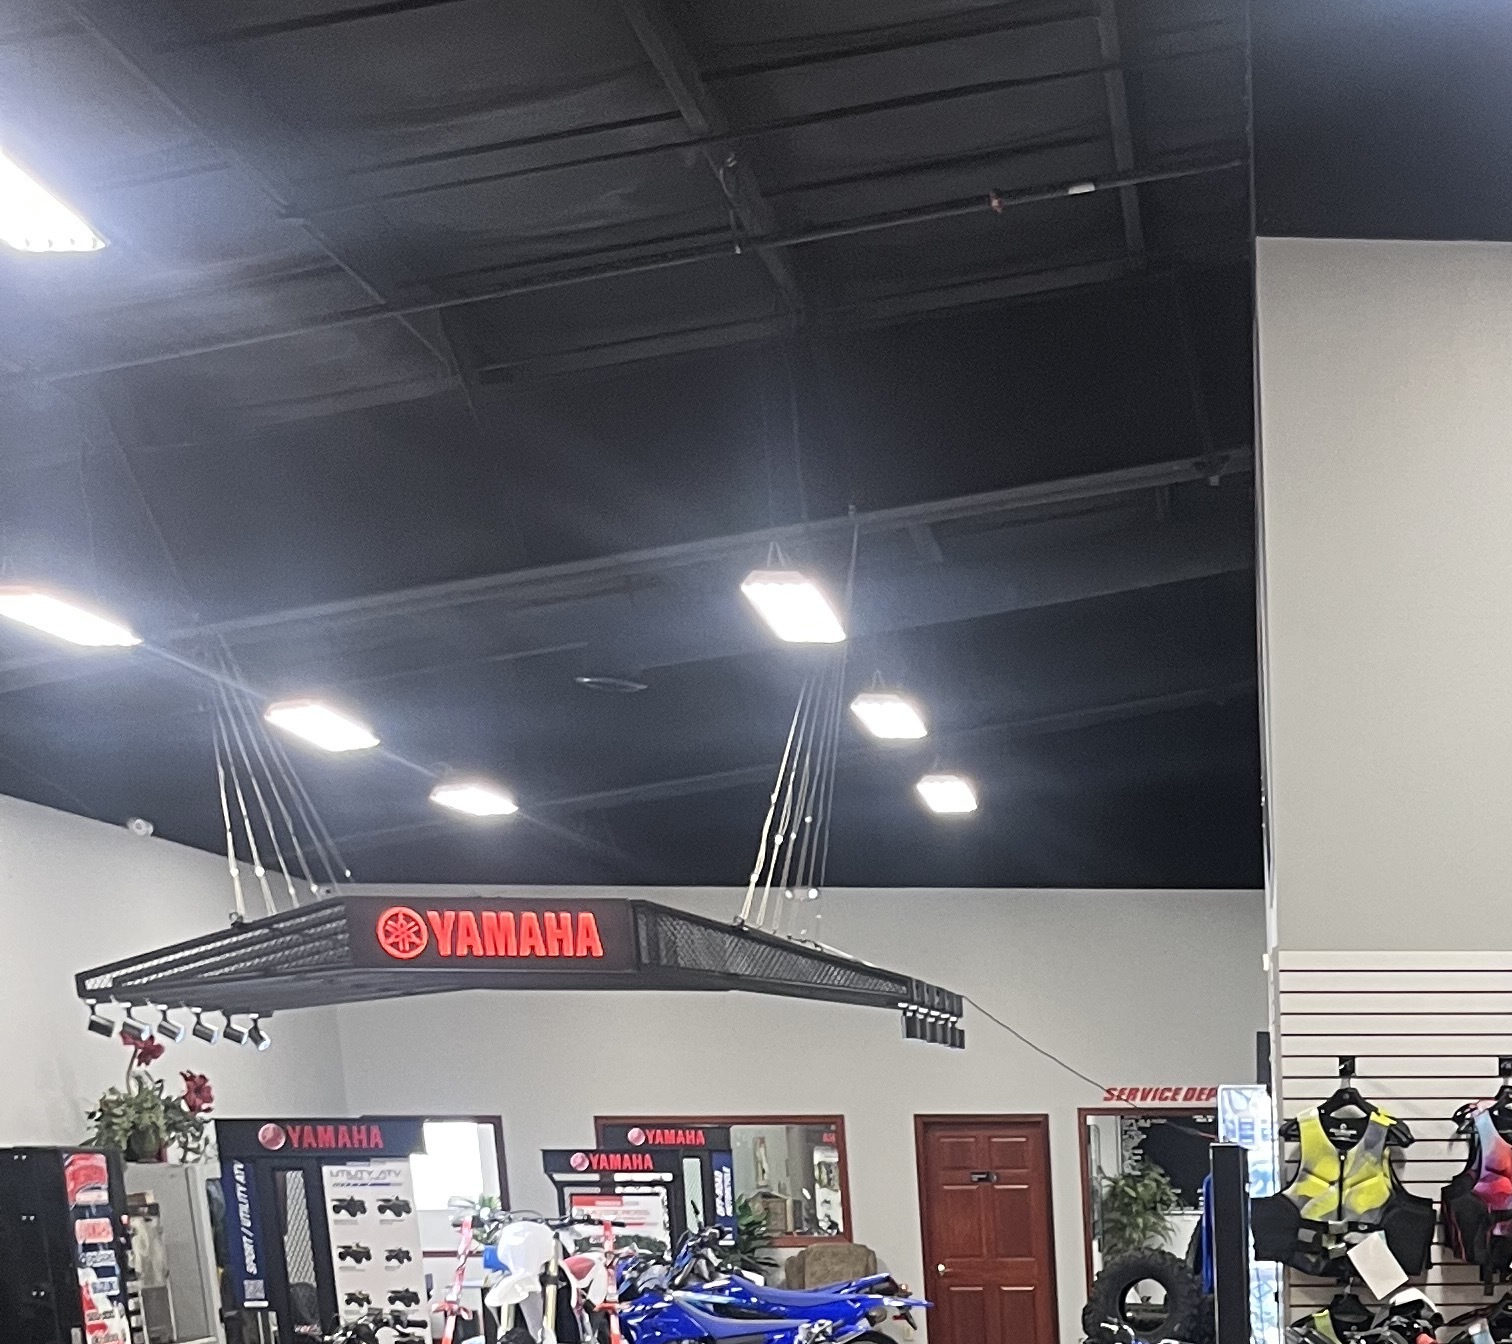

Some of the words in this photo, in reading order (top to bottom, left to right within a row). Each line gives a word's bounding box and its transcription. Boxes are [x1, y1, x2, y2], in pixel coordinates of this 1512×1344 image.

[426, 910, 604, 957] YAMAHA
[1103, 1087, 1181, 1102] SERVICE
[1182, 1087, 1217, 1102] DEP
[286, 1124, 384, 1149] YAMAHA
[645, 1129, 705, 1145] YAMAHA
[589, 1153, 653, 1170] YAMAHA
[242, 1235, 257, 1275] SPORT
